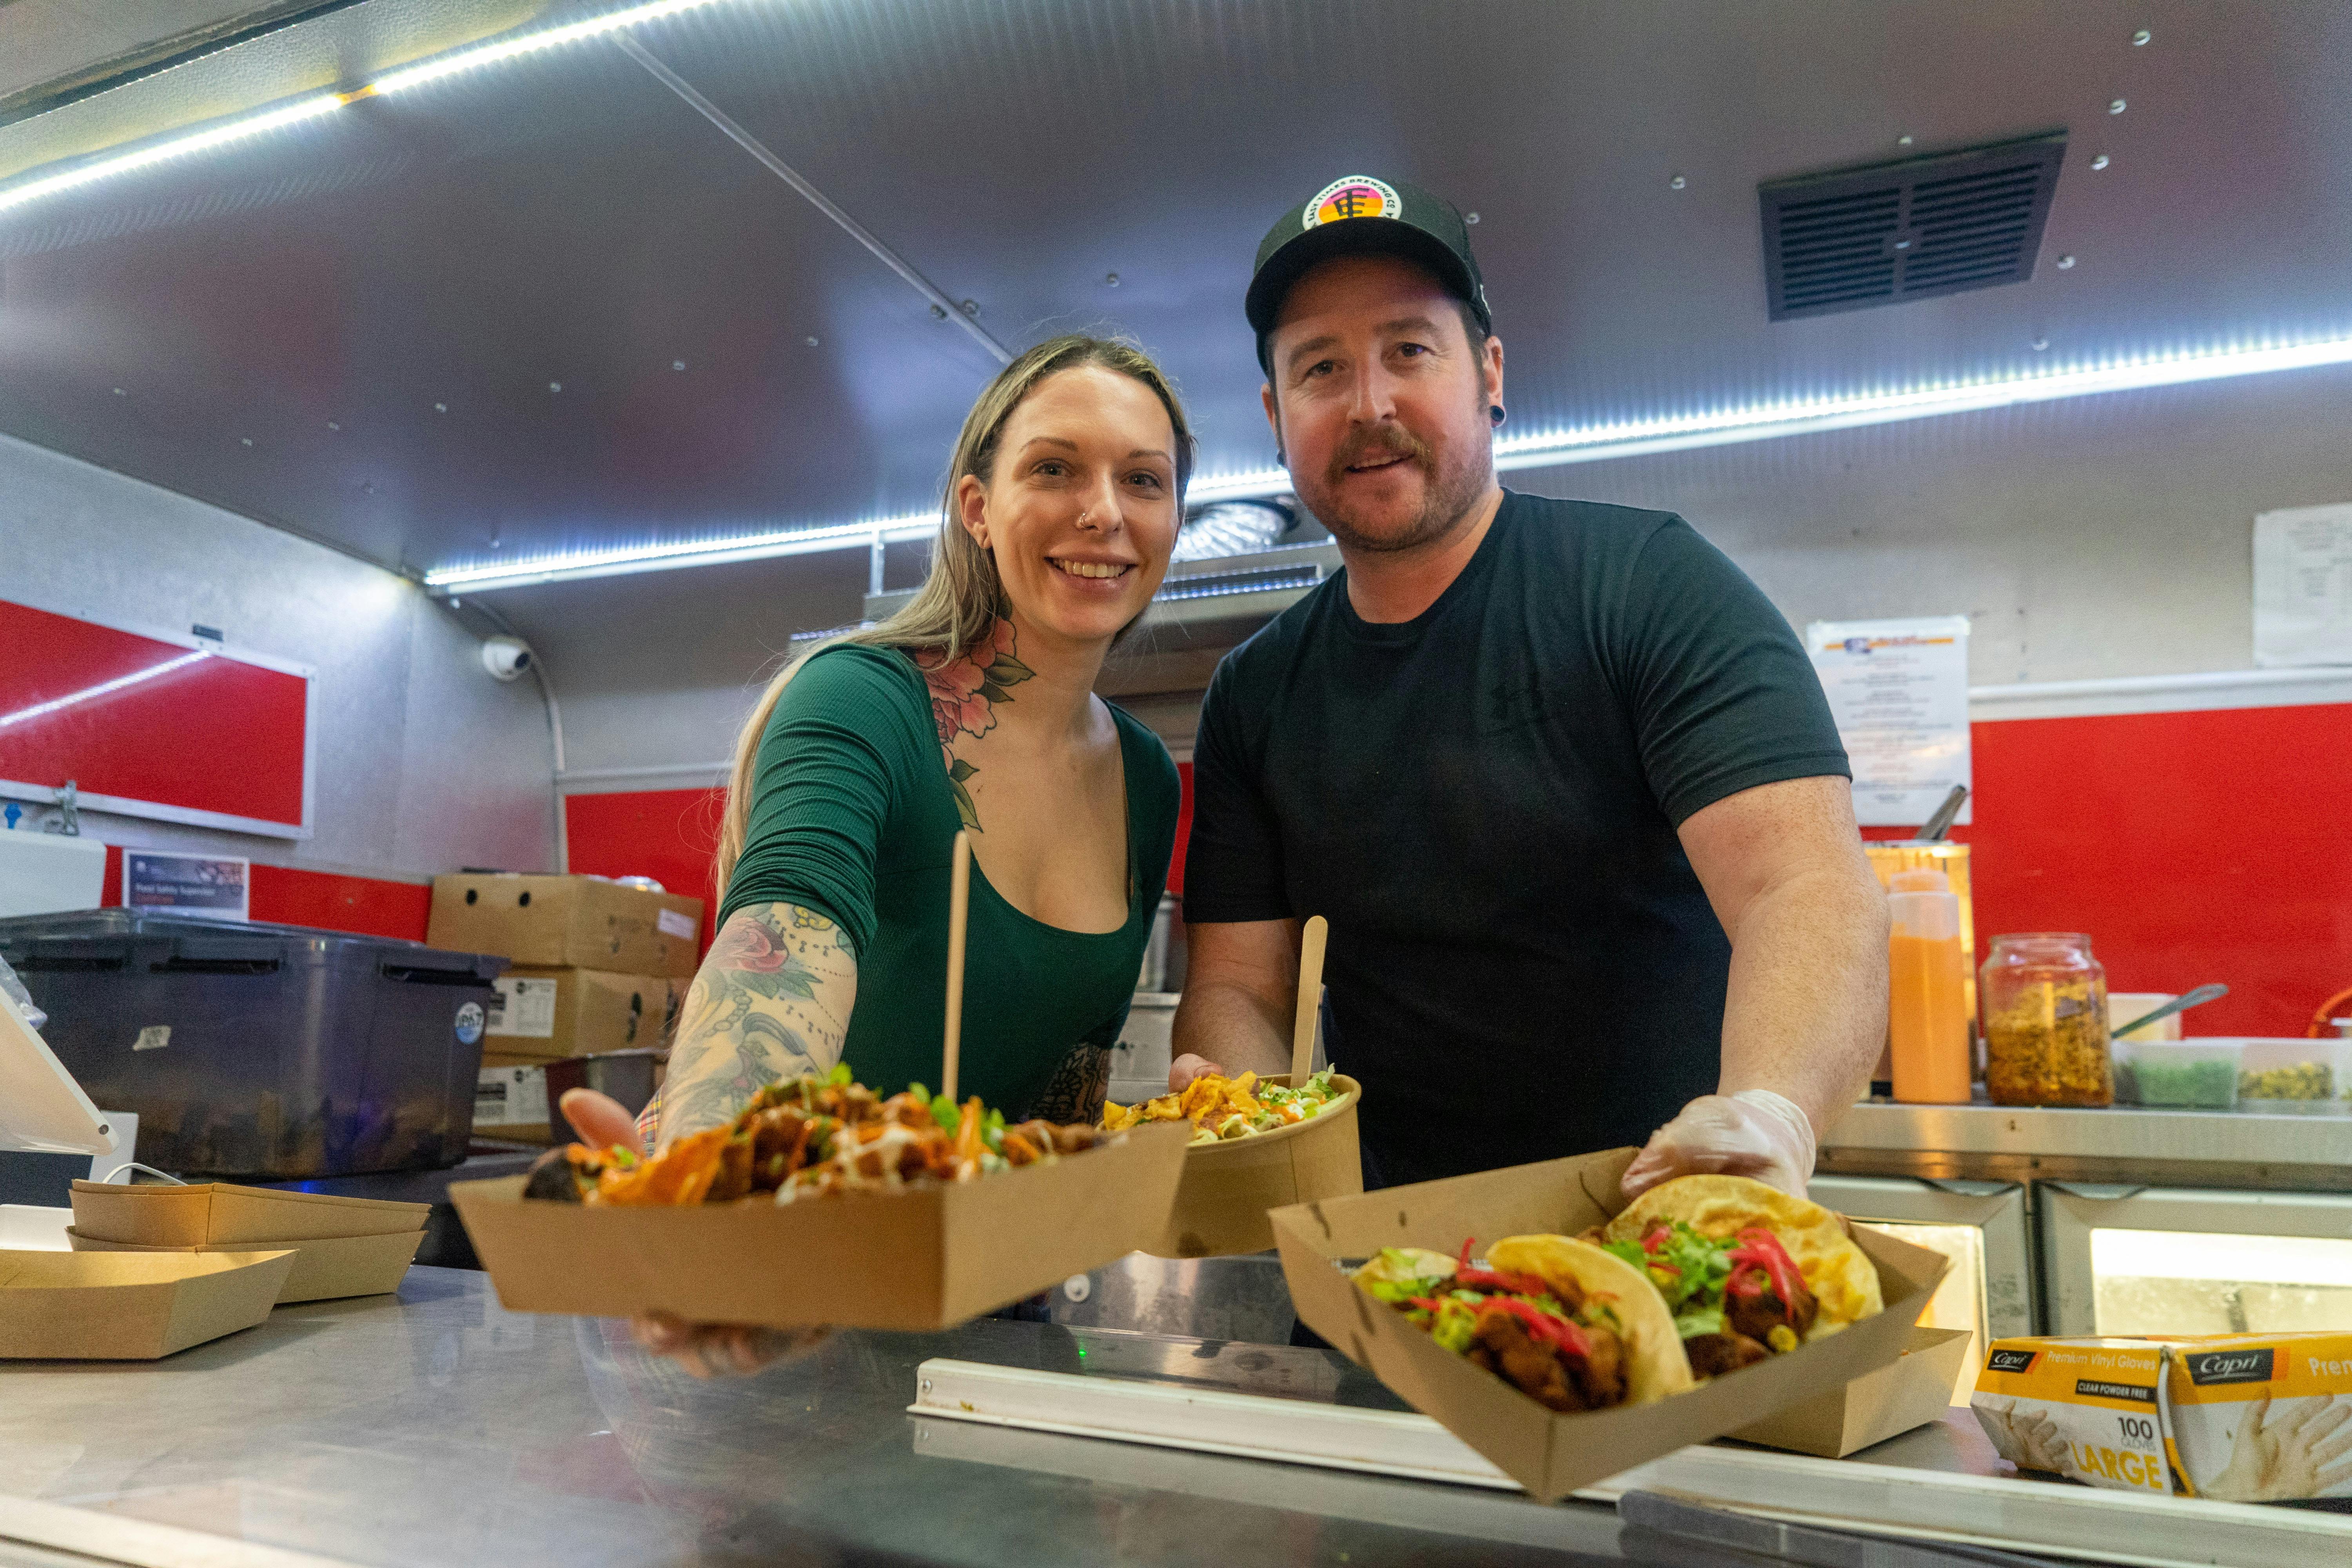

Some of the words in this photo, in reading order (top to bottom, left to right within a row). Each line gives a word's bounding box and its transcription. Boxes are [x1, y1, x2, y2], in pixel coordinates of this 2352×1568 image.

[1317, 181, 1346, 201] TIMES
[1350, 178, 1392, 198] BREWING
[1994, 1352, 2027, 1365] Capri
[2047, 1350, 2088, 1364] Premium
[2091, 1354, 2115, 1368] Vinyl
[2118, 1355, 2156, 1371] Gloves
[2200, 1354, 2259, 1377] Capri
[2078, 1382, 2099, 1394] CLEAR
[2100, 1384, 2130, 1397] POWDER
[2131, 1388, 2148, 1399] FREE
[2118, 1417, 2153, 1440] 100
[2070, 1440, 2163, 1489] LARGE
